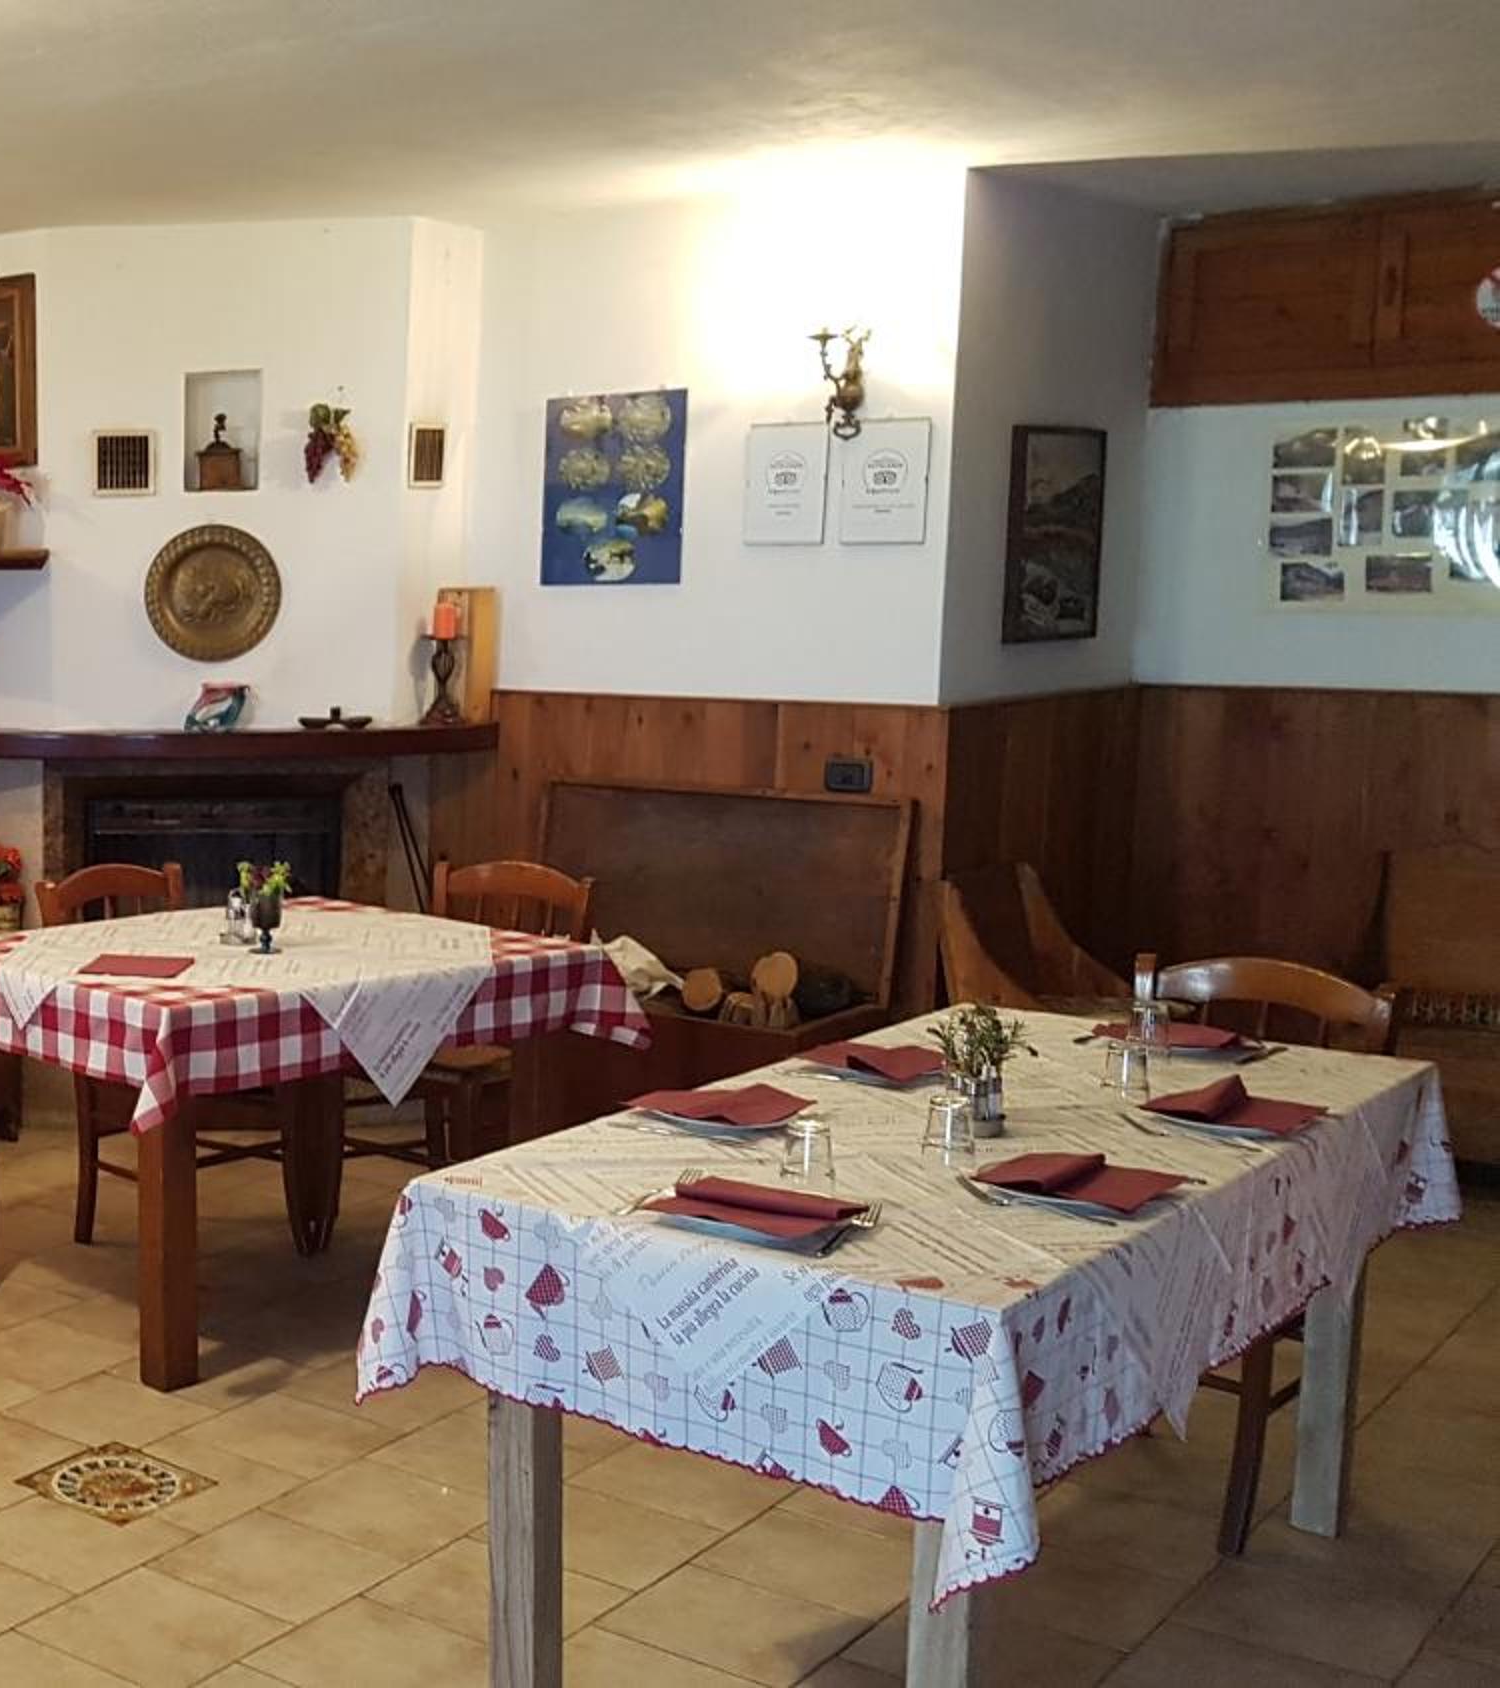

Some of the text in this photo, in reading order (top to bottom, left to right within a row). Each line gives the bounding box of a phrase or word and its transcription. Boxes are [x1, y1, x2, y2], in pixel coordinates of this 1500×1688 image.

[668, 1290, 701, 1321] massaia
[697, 1257, 739, 1295] canterina
[692, 1298, 724, 1328] allegra
[728, 1265, 759, 1296] cucina
